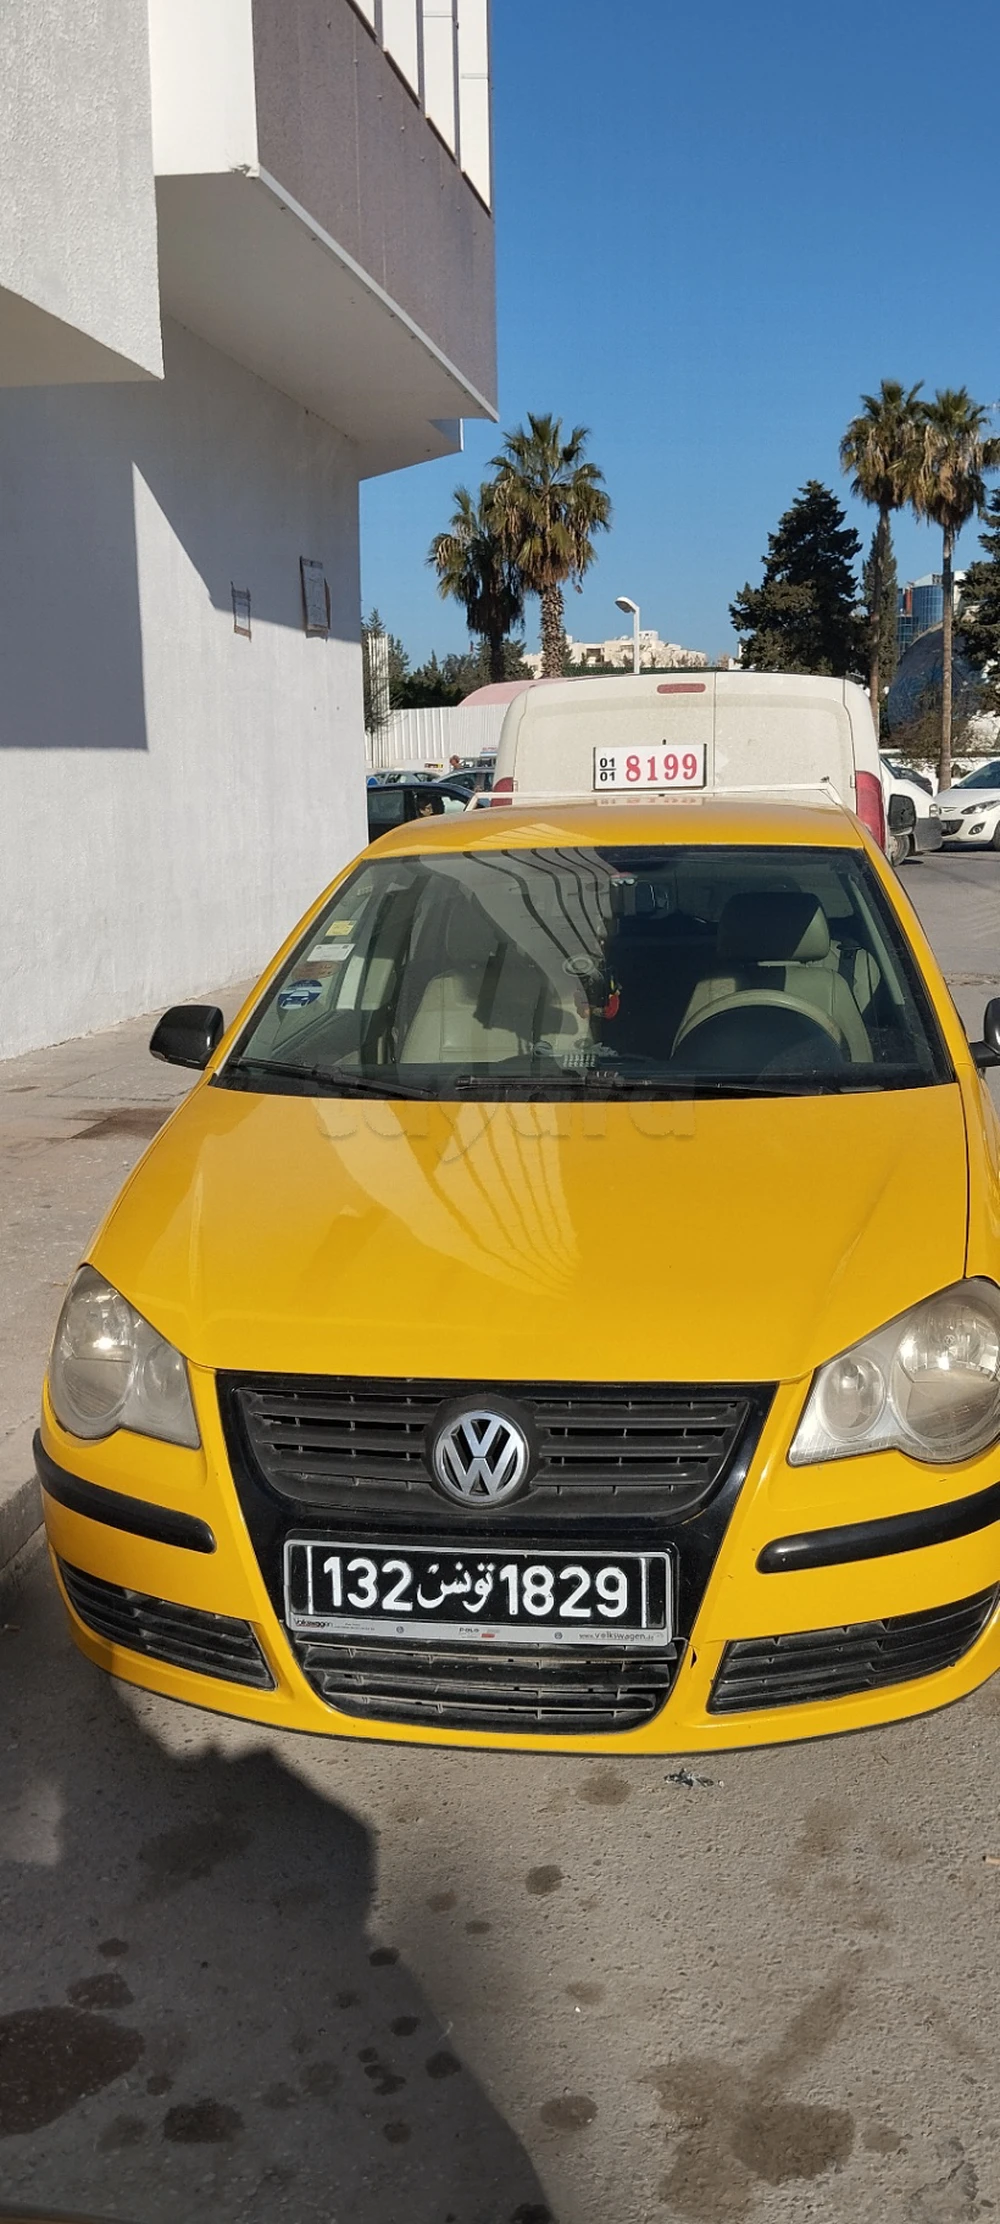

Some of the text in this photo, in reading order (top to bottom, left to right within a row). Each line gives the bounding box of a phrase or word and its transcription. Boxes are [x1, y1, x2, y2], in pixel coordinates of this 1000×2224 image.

[599, 757, 616, 768] 01
[599, 771, 616, 782] 01
[625, 753, 698, 782] 8199
[436, 1411, 525, 1502] VW
[323, 1556, 629, 1618] 132 تونس 1829
